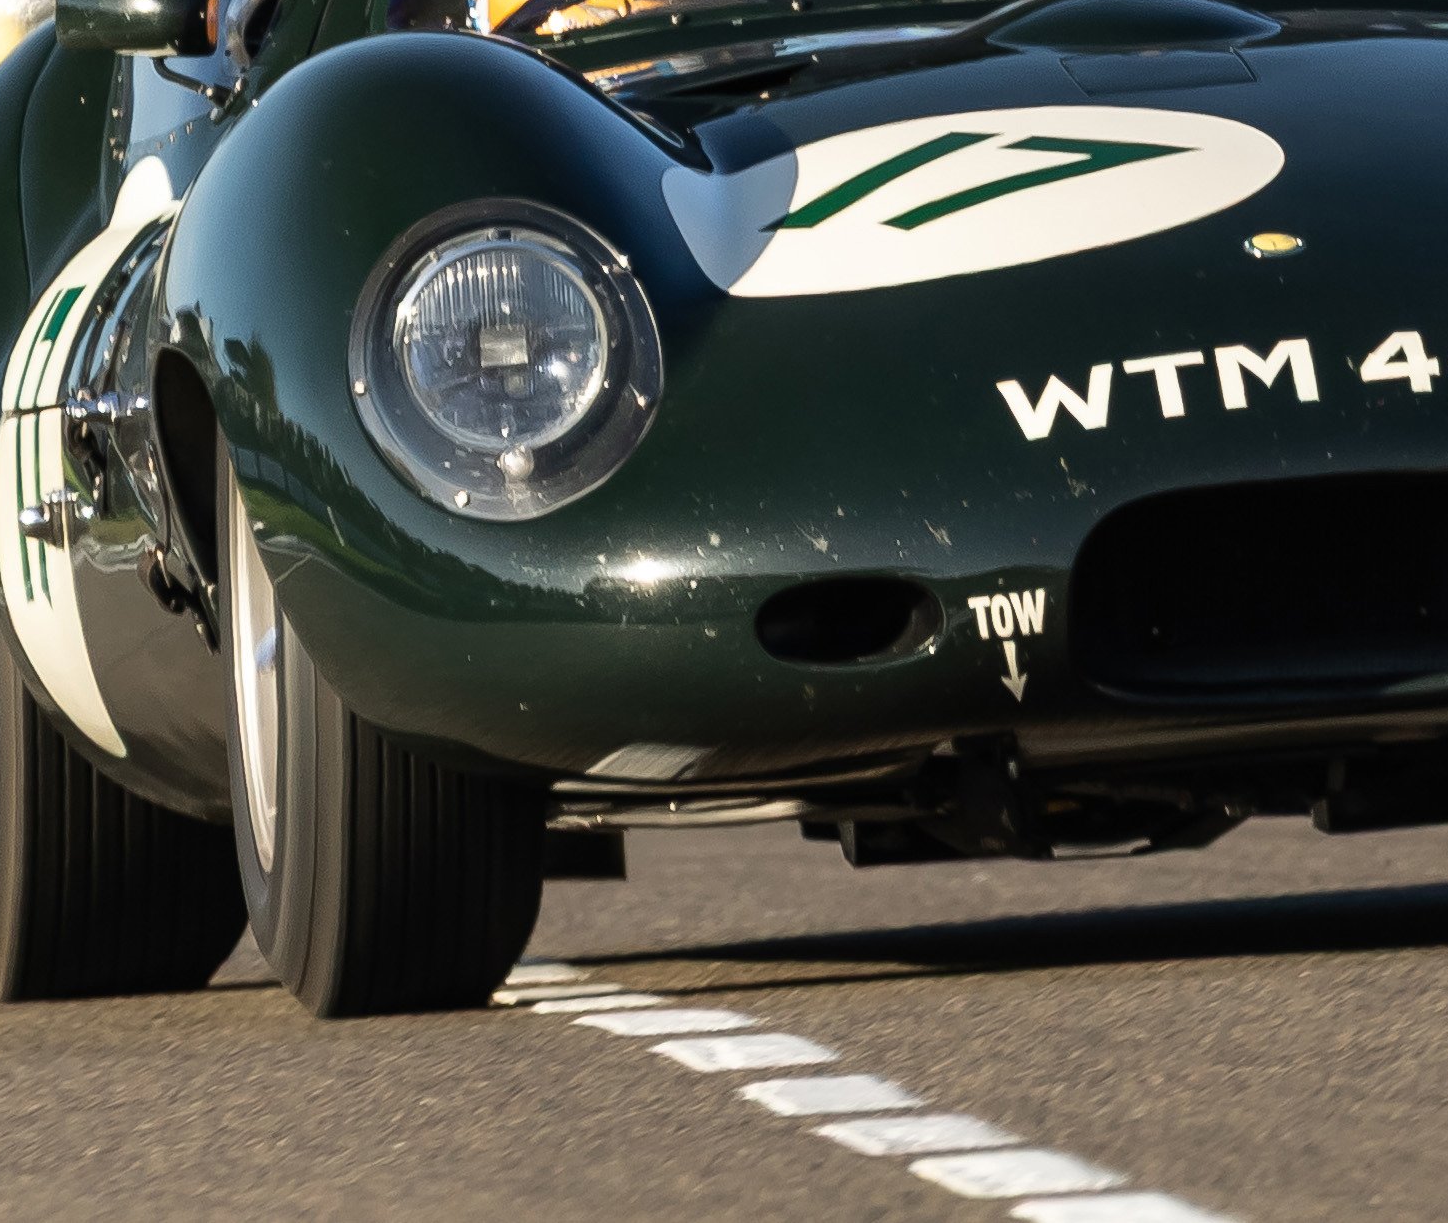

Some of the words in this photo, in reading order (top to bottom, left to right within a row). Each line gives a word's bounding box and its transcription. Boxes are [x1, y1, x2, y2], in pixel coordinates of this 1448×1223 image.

[759, 131, 1203, 231] 17
[996, 337, 1320, 442] WTM
[967, 588, 1045, 642] TOW
